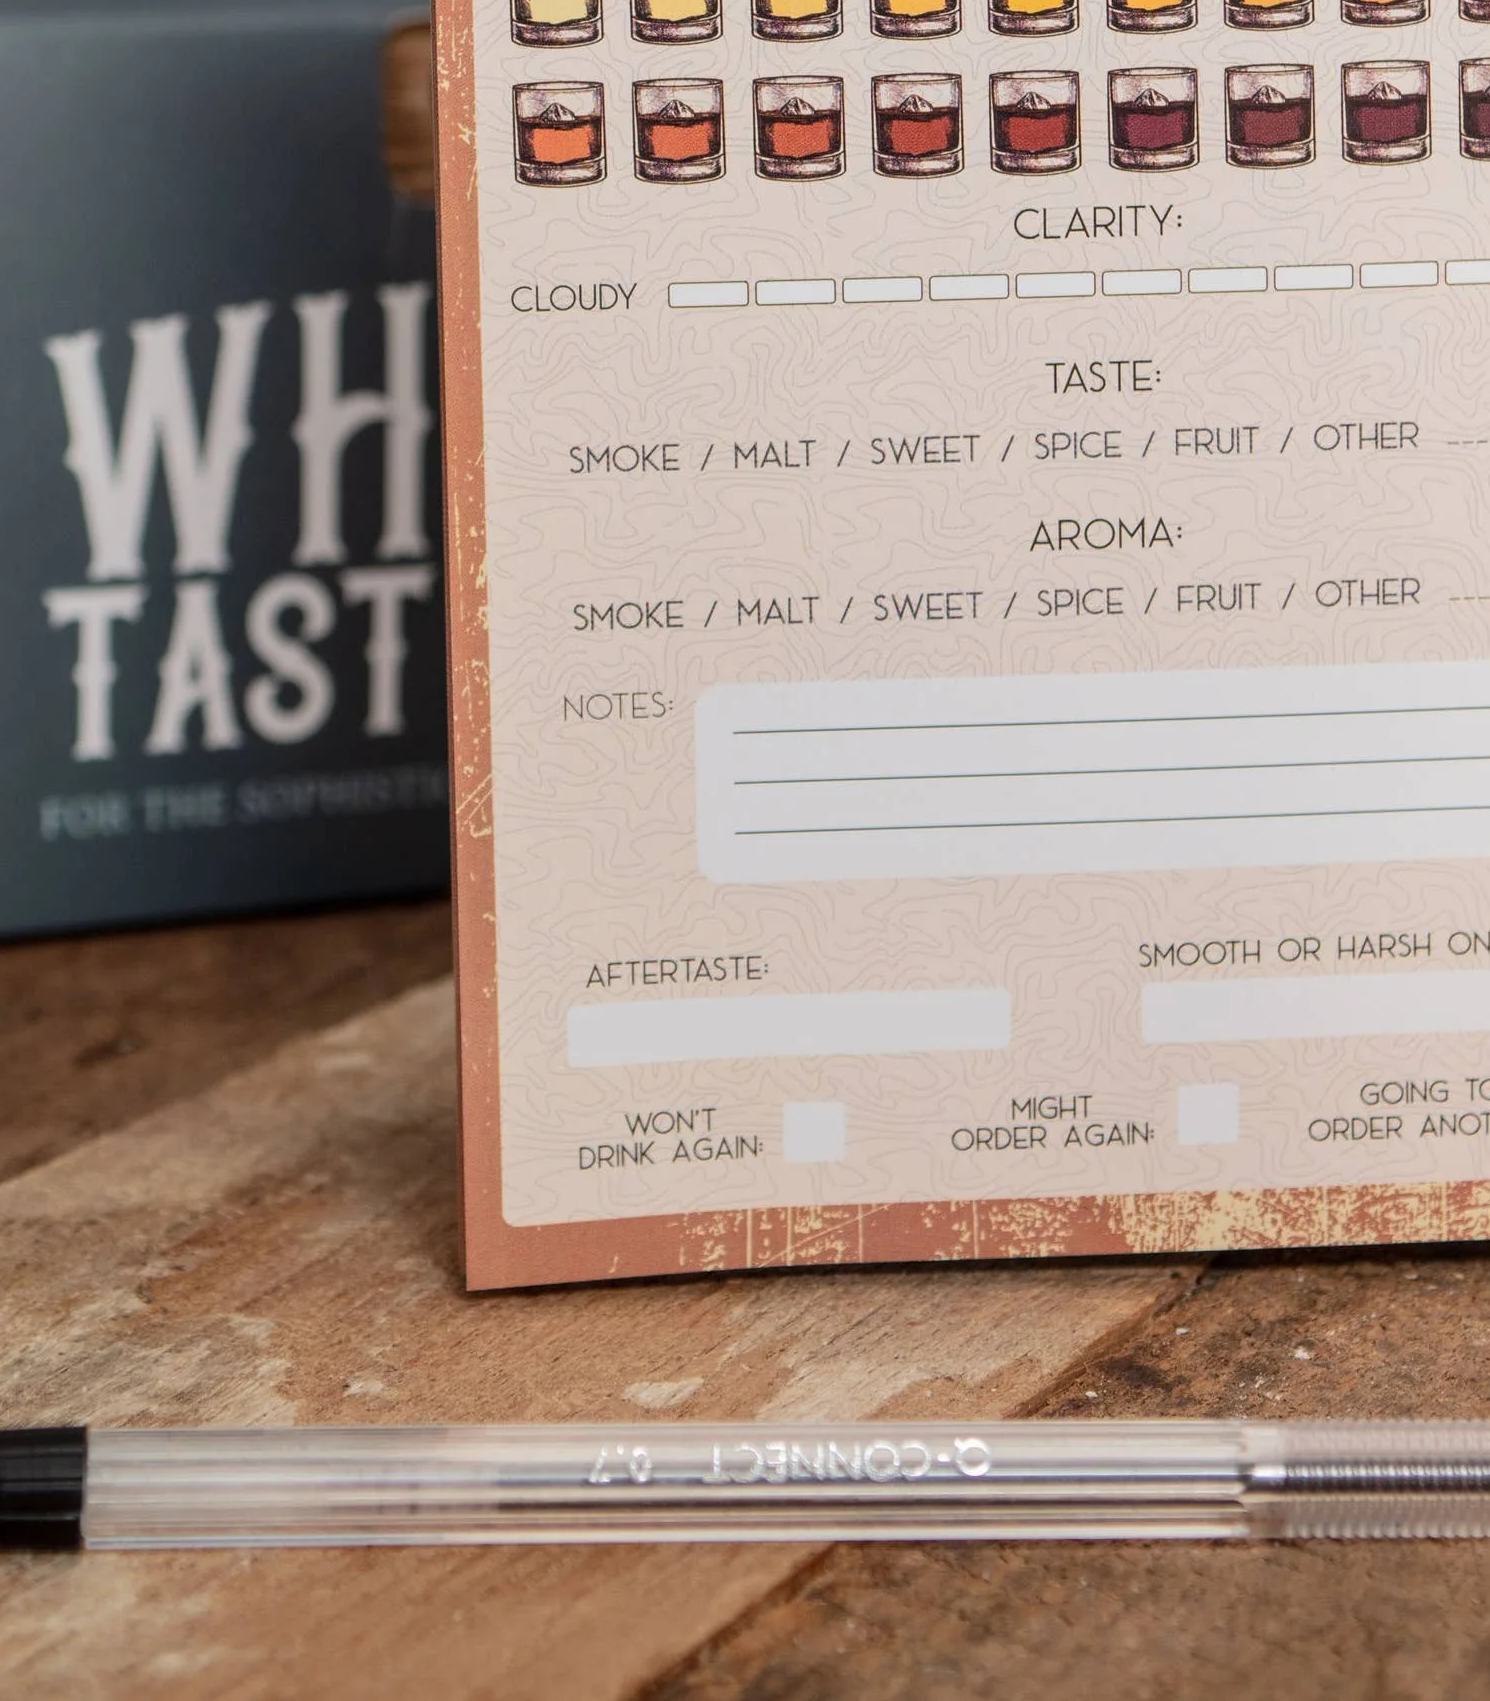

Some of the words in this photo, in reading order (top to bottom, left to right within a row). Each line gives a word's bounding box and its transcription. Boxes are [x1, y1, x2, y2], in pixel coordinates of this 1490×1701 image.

[1013, 205, 1183, 239] CLARITY:
[510, 283, 638, 313] CLOUDY
[1045, 360, 1162, 394] TASTE:
[569, 444, 680, 474] SMOKE
[733, 440, 816, 469] MALT
[870, 435, 980, 465] SWEET
[1034, 431, 1122, 461] SPICE
[1174, 426, 1260, 456] FRUIT
[1313, 421, 1420, 451] OTHER
[1030, 516, 1183, 551] AROMA:
[573, 601, 684, 631] SMOKE
[737, 597, 820, 626] MALT
[873, 592, 983, 621] SWEET
[1037, 588, 1124, 617] SPICE
[1176, 583, 1261, 613] FRUIT
[1315, 578, 1421, 608] OTHER
[563, 692, 673, 722] NOTES:
[1138, 940, 1261, 968] SMOOTH
[1278, 937, 1321, 962] OR
[1338, 932, 1432, 959] HARSH
[586, 955, 769, 989] AFTERTASTE:
[1011, 1095, 1093, 1121] MIGHT
[1359, 1079, 1450, 1106] GOING
[625, 1107, 717, 1136] WON'T
[951, 1124, 1047, 1152] ORDER
[1064, 1122, 1155, 1149] AGAIN:
[1308, 1116, 1403, 1143] ORDER
[578, 1142, 655, 1170] DRINK
[672, 1135, 764, 1164] AGAIN:
[702, 1437, 991, 1483] Q-CONNECT
